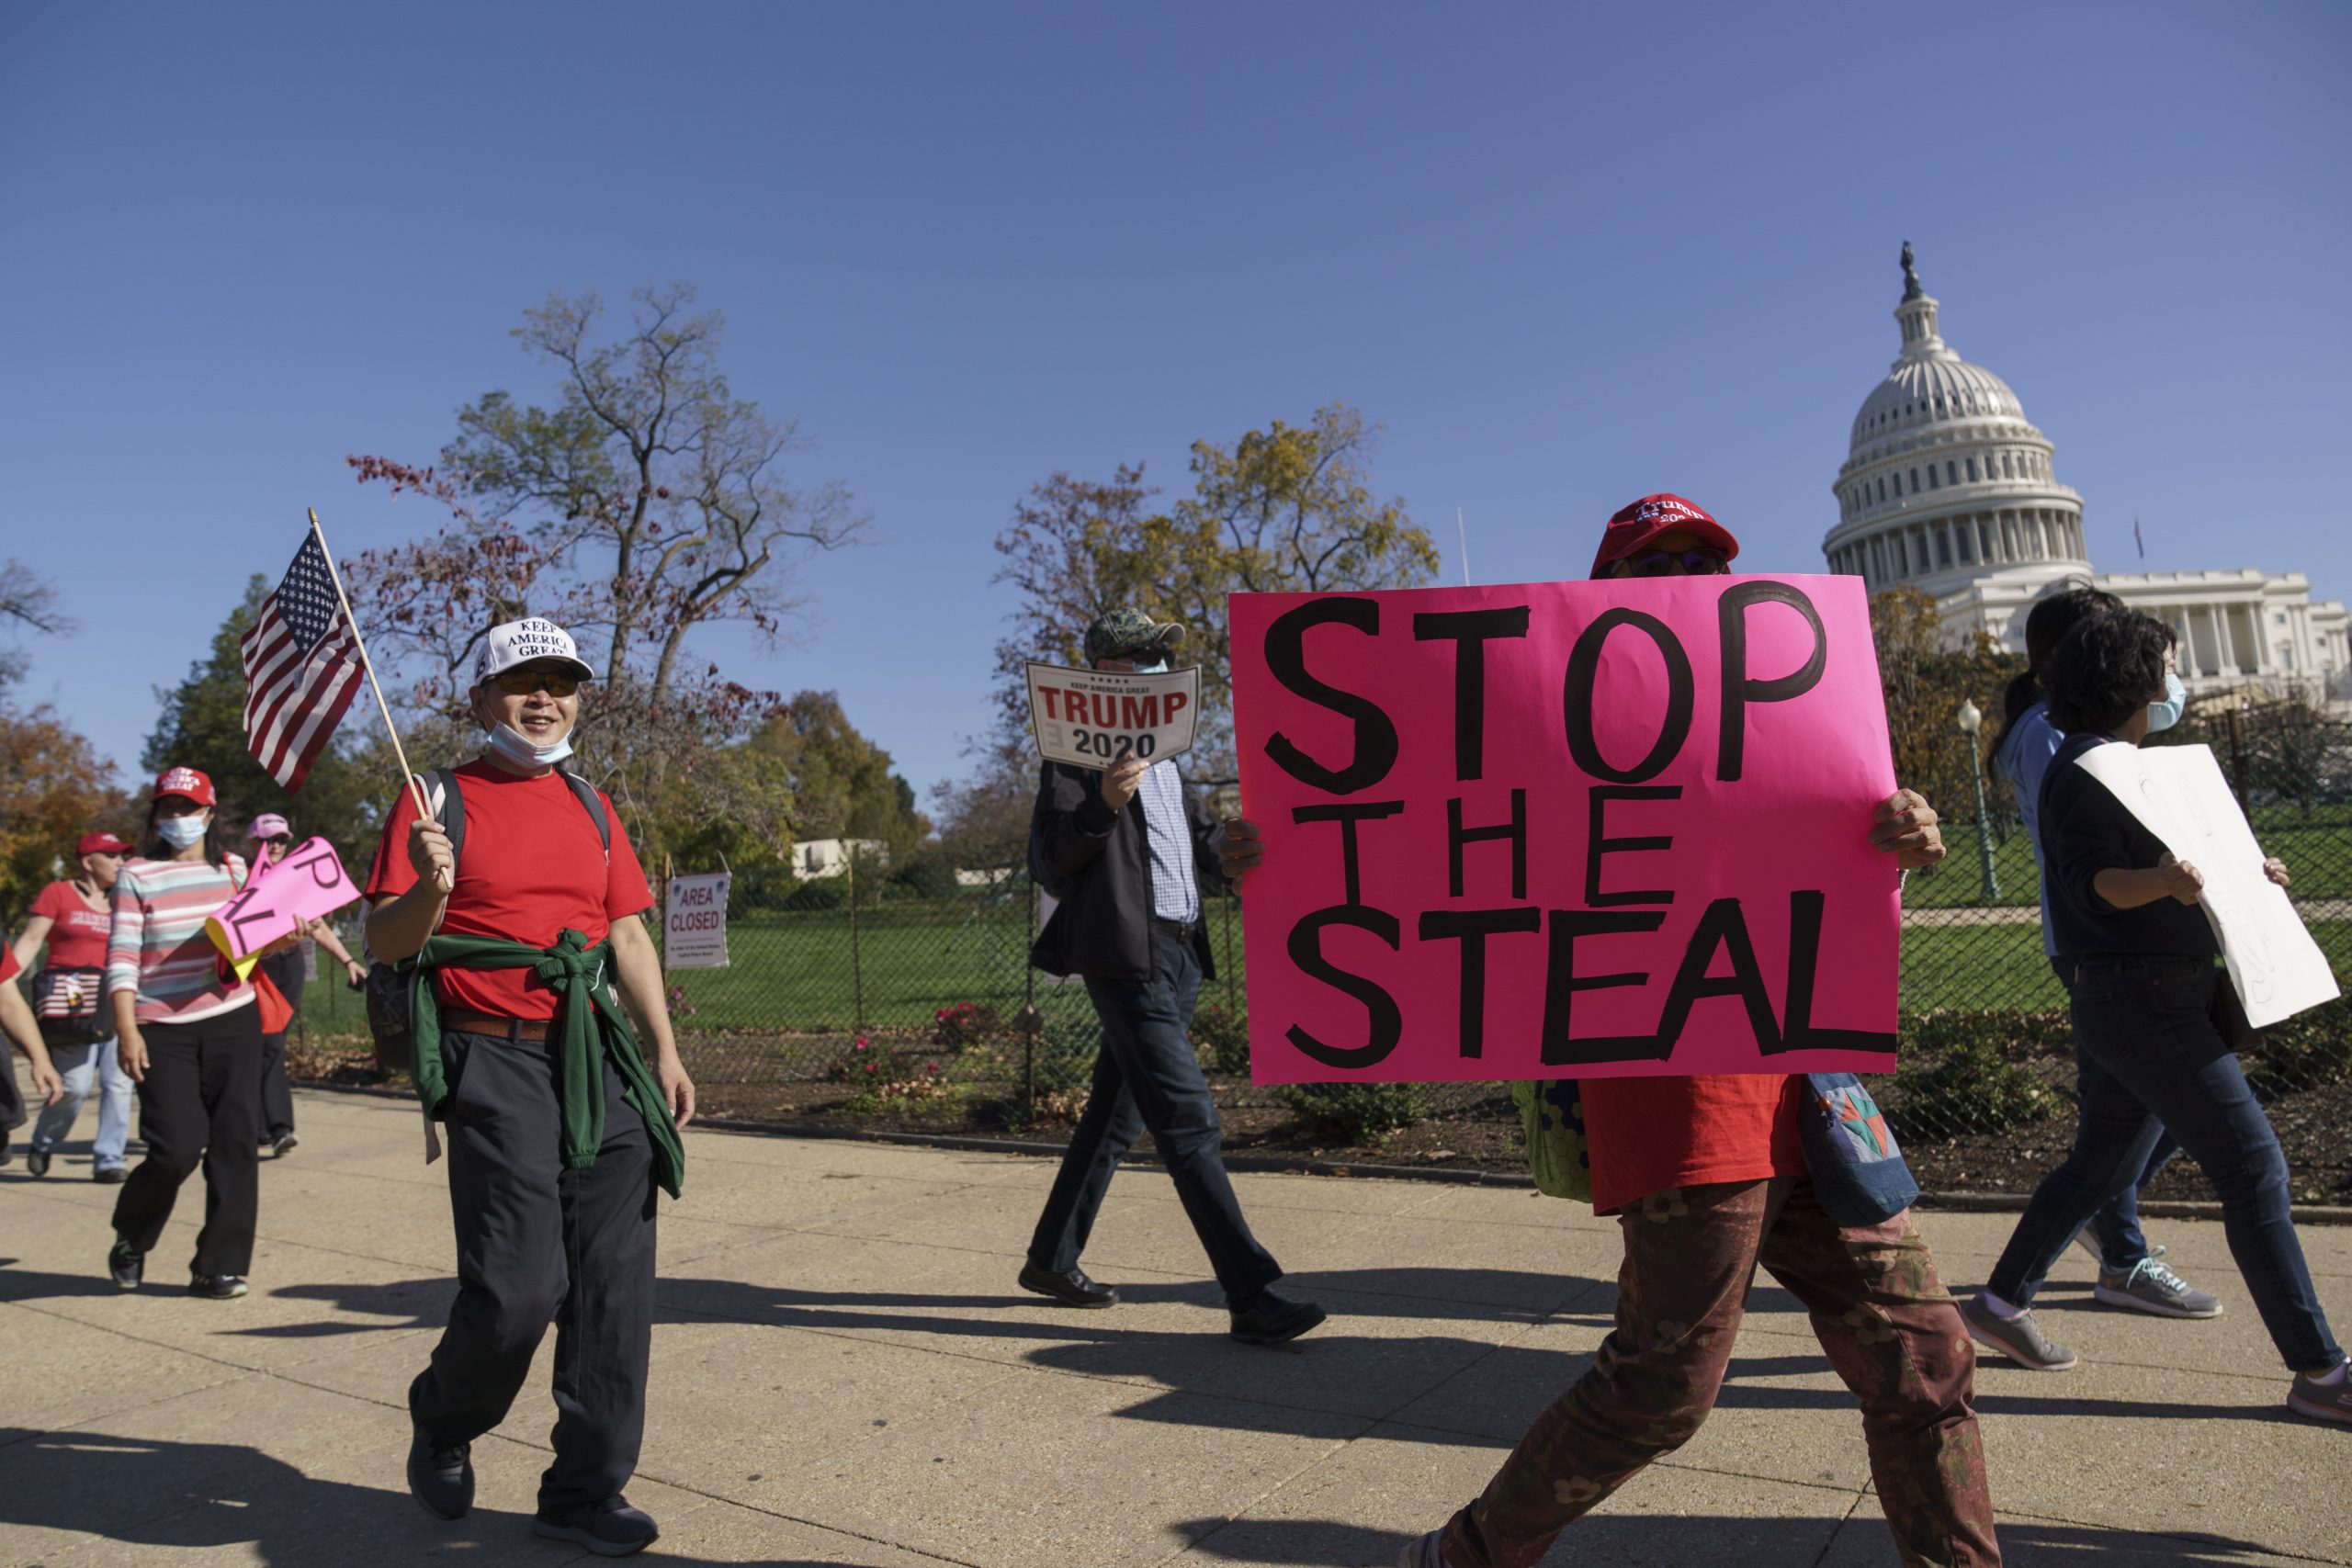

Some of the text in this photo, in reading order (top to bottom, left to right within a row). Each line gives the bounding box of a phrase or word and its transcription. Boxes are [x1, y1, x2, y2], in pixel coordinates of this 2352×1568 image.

[1635, 500, 1705, 520] Trump
[1070, 682, 1150, 694] KEEP AMERICA GREAT
[1264, 581, 1827, 796] STOP
[1037, 685, 1188, 730] TRUMP
[1073, 728, 1156, 760] 2020
[1291, 785, 1684, 908] THE
[681, 887, 714, 907] AREA
[671, 911, 719, 932] CLOSED
[1285, 890, 1898, 1072] STEAL
